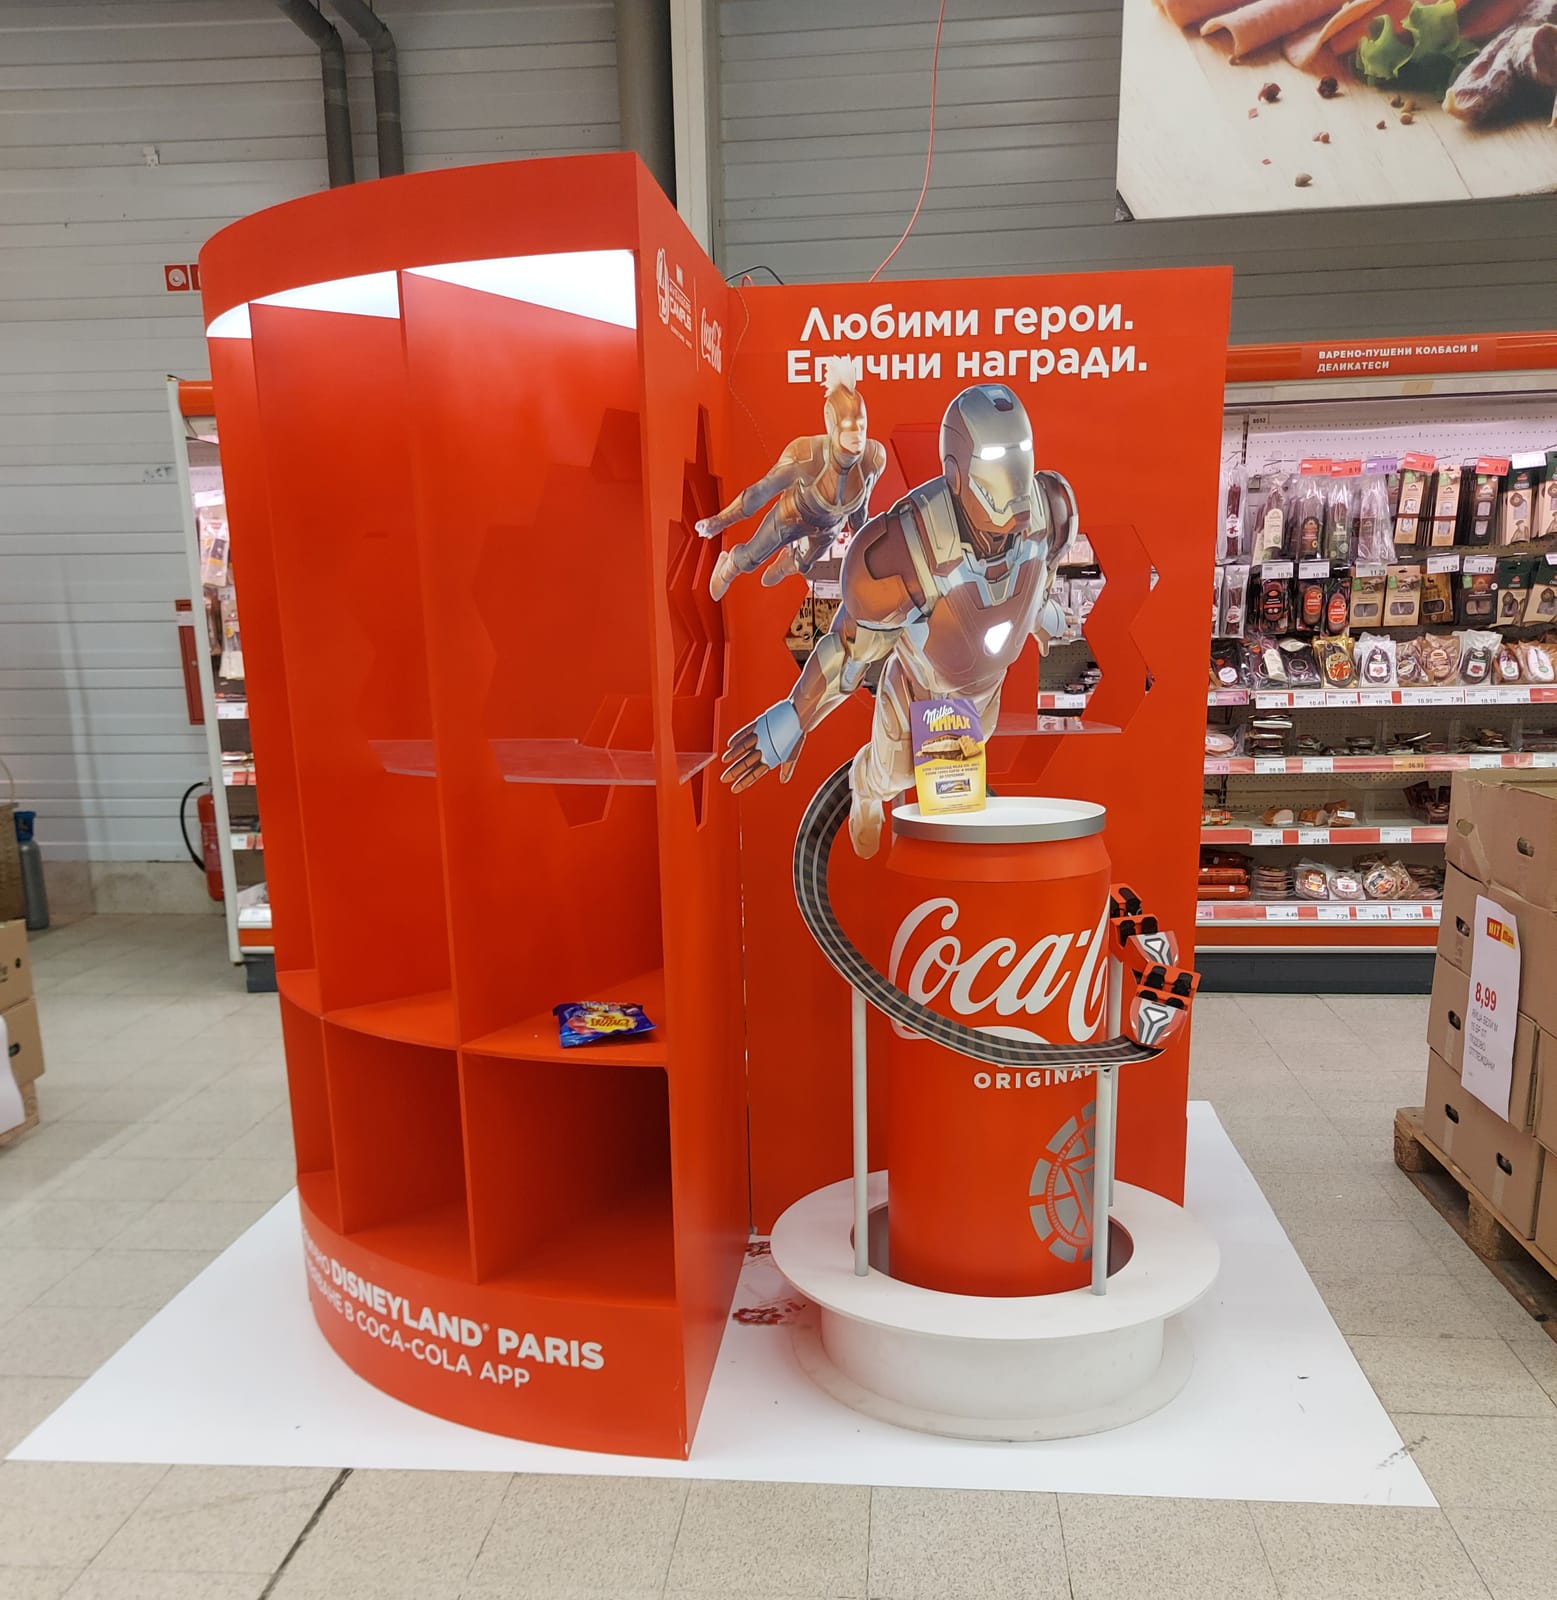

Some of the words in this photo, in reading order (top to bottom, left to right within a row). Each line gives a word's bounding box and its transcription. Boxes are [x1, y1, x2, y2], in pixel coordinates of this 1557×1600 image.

[800, 303, 979, 342] Любими
[994, 303, 1135, 340] герои.
[956, 345, 1149, 383] награди.
[1317, 360, 1390, 373] ДЕЛИКАТЕСИ
[1318, 347, 1412, 359] ВАРЕНО-ПУШЕНИ
[1415, 344, 1467, 355] КОЛБАСИ
[1470, 344, 1479, 353] И
[922, 704, 955, 725] Milka
[1475, 981, 1497, 1011] 8,99
[356, 1309, 473, 1377] COCA-COLA
[480, 1360, 531, 1388] APP
[497, 1327, 605, 1370] PARIS
